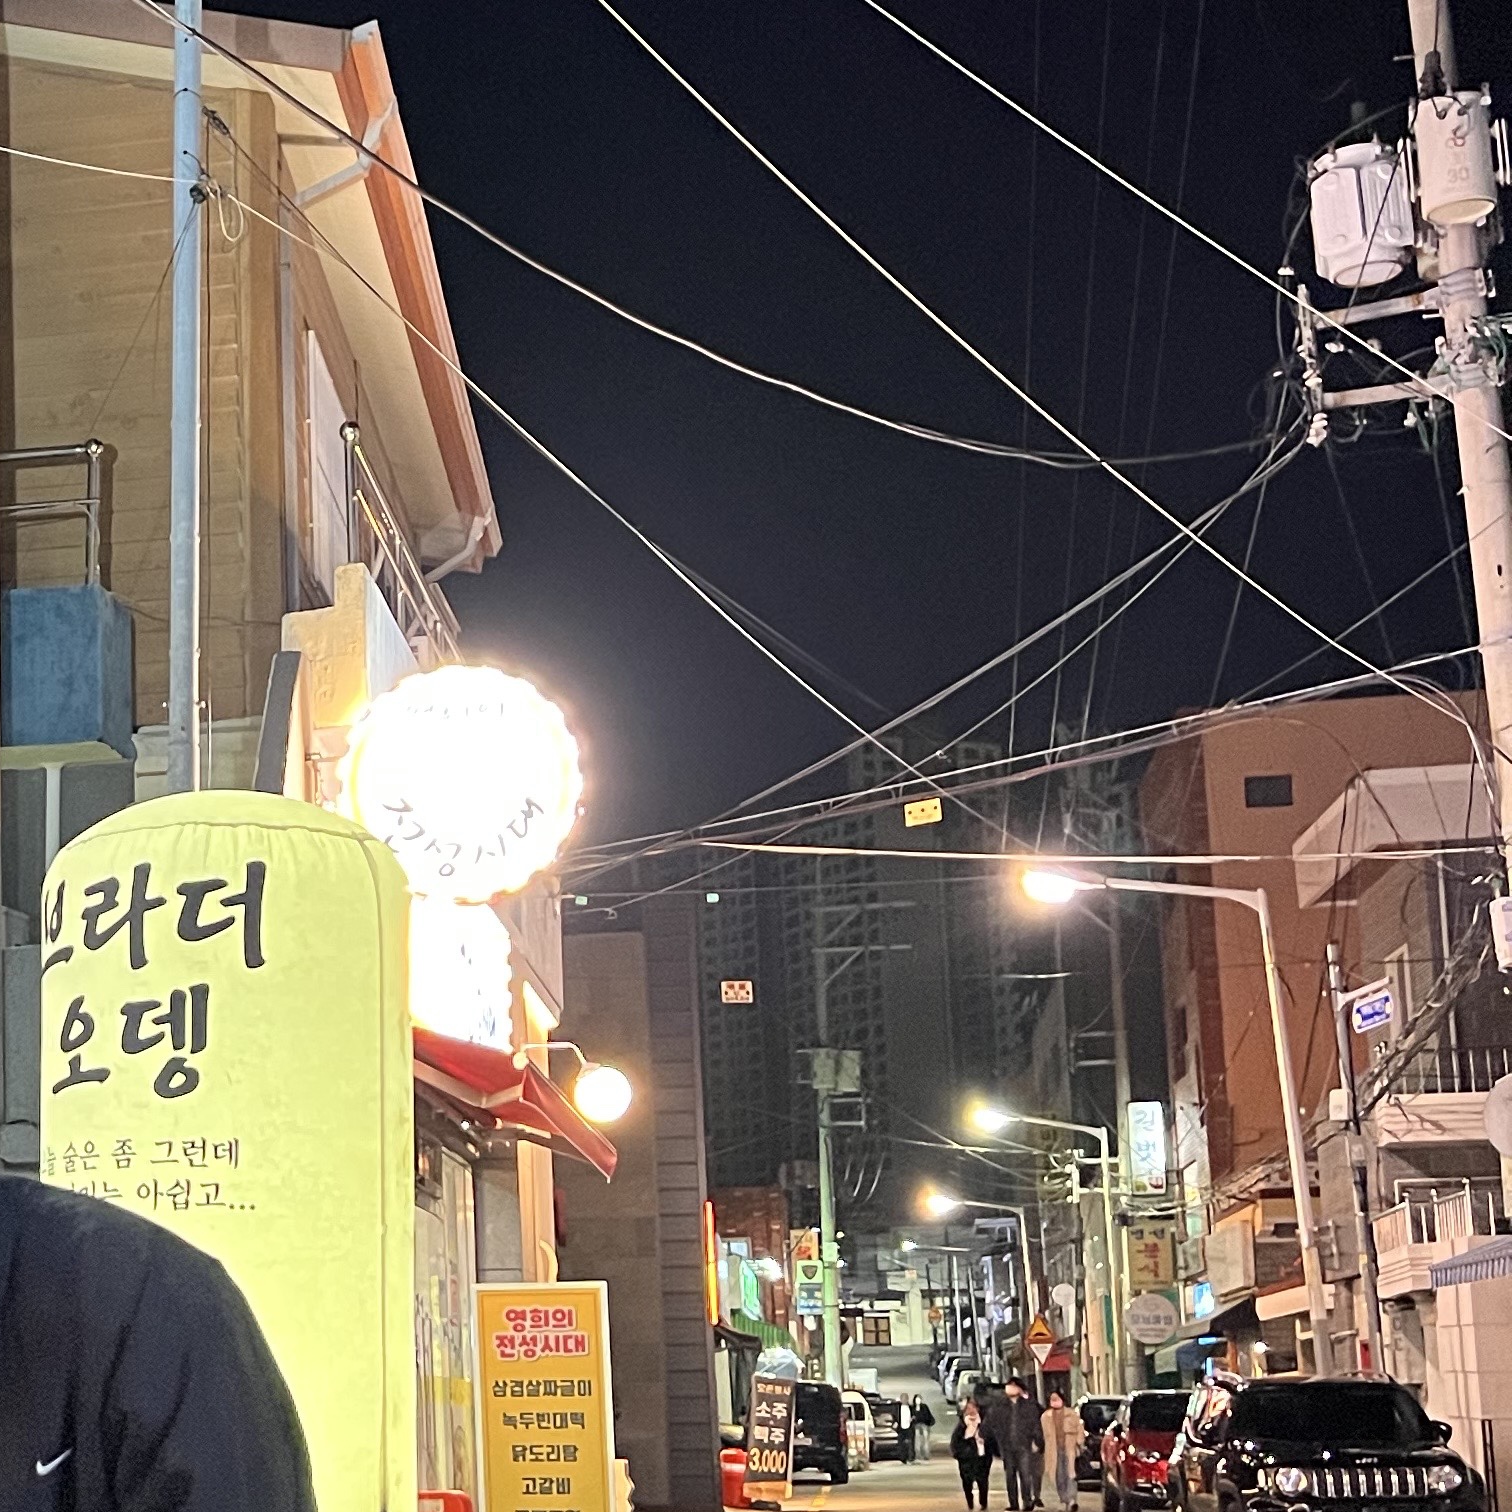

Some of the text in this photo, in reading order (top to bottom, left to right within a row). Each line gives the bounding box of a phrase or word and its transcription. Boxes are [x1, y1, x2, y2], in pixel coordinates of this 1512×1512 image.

[53, 983, 210, 1098] 오뎅
[63, 1140, 100, 1173] 술은
[111, 1138, 137, 1169] 좀
[150, 1137, 239, 1169] 그런데
[505, 1308, 574, 1332] 영희의
[495, 1334, 586, 1359] 전성시대
[502, 1412, 585, 1429] 녹두빈대떡
[755, 1401, 787, 1419] 소주
[512, 1444, 579, 1462] 닭도리탕
[749, 1447, 786, 1474] 3,000
[521, 1477, 571, 1495] 고갈비
